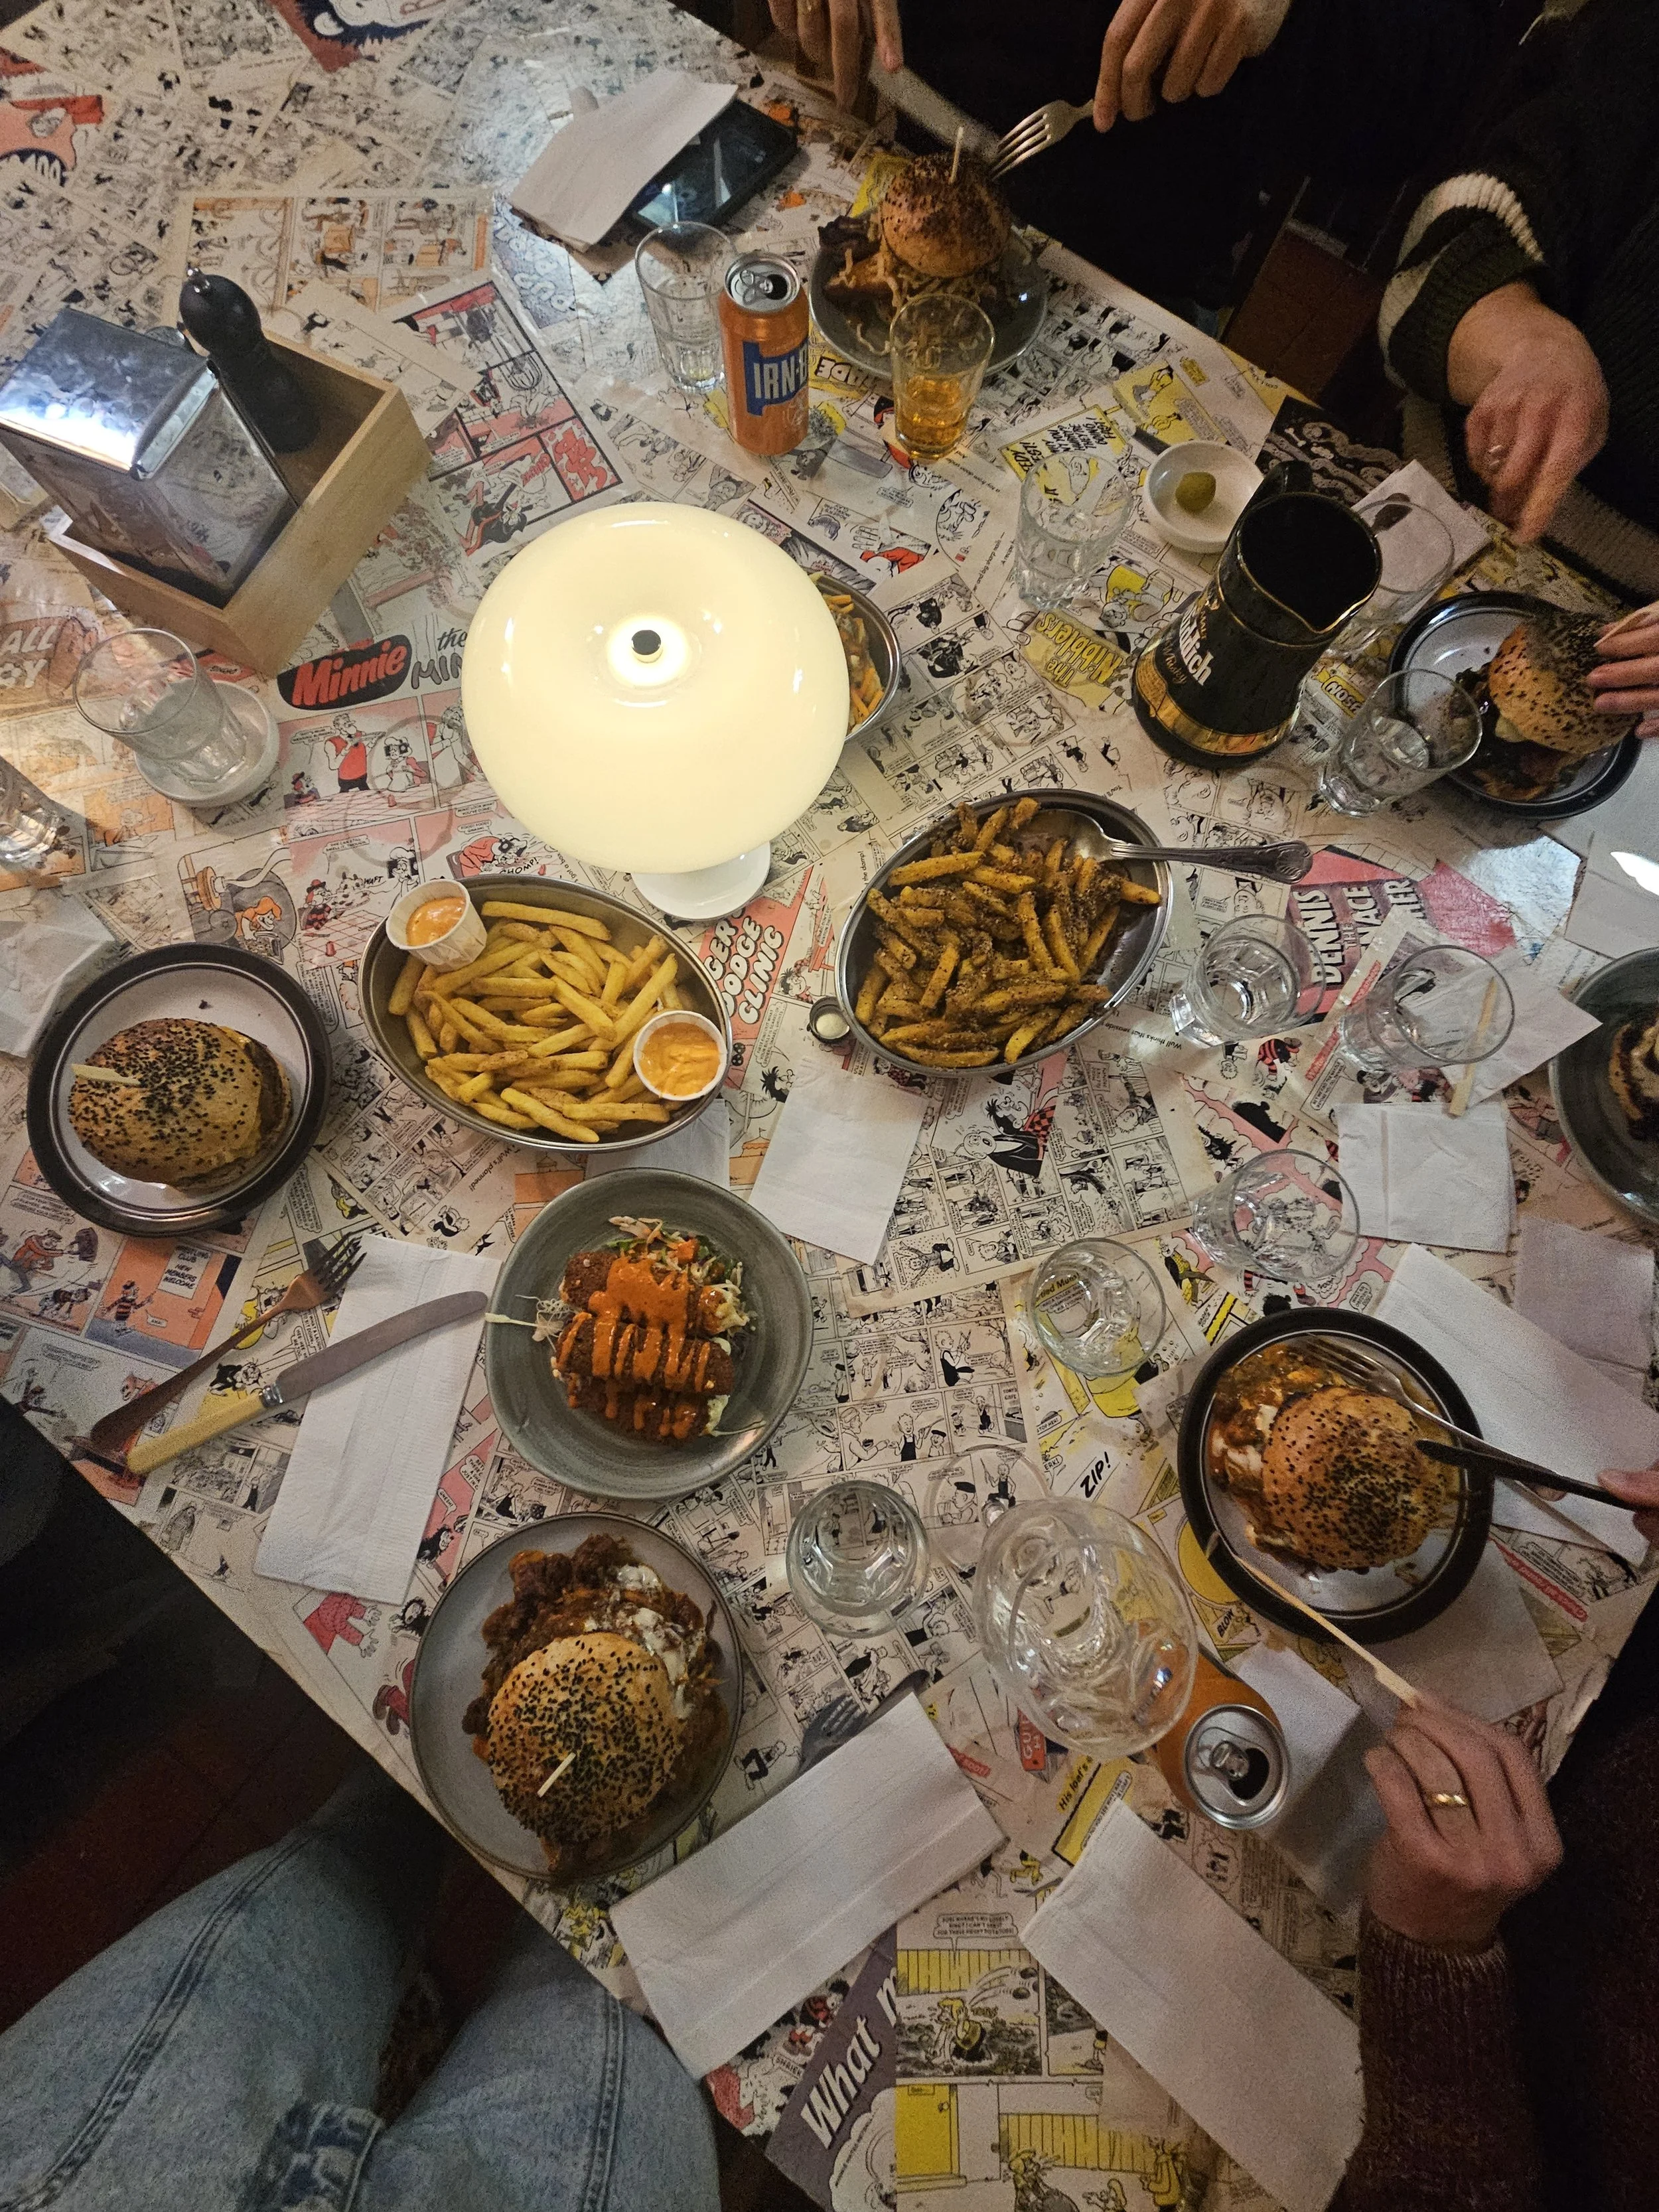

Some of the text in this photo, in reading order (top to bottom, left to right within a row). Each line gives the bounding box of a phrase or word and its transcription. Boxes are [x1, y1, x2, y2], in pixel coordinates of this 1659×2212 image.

[1035, 611, 1124, 686] Nibblers
[292, 628, 467, 707] Minnie the
[1046, 658, 1076, 688] The
[857, 850, 870, 870] damp!
[364, 876, 384, 885] WAFT
[1342, 886, 1382, 953] NACE
[1293, 890, 1345, 985] DENNIS
[1342, 923, 1358, 950] THE
[739, 926, 784, 1024] CLINIC
[1145, 1033, 1165, 1045] thinks
[1166, 1040, 1183, 1049] Wull
[467, 1143, 512, 1194] Wull's planned!
[175, 1263, 192, 1272] NEW
[177, 1253, 197, 1263] CLUB
[163, 1276, 196, 1290] WELCOME
[165, 1269, 197, 1282] MEMBERS
[1035, 1423, 1048, 1432] STOP
[1081, 1452, 1111, 1498] ZIP!
[801, 2017, 881, 2150] What
